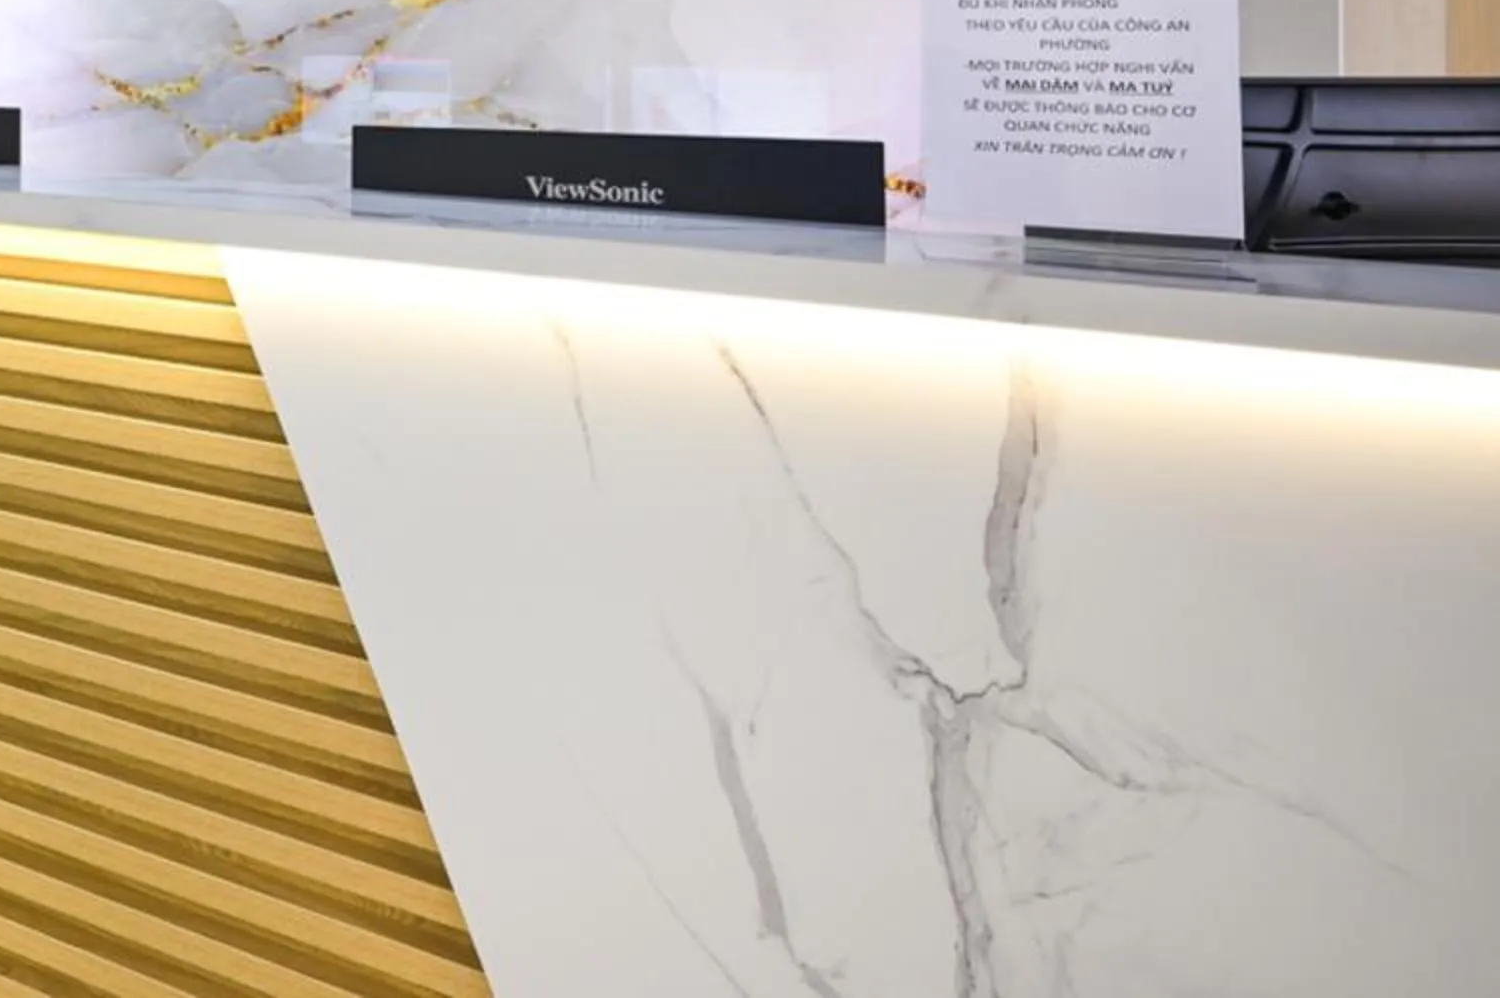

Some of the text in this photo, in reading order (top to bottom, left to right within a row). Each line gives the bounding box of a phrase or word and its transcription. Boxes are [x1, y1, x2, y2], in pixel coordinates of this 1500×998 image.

[965, 18, 1006, 32] THEO
[1166, 18, 1190, 32] AN
[1113, 61, 1155, 75] NGHI
[1108, 80, 1138, 94] MA
[1132, 103, 1168, 117] CHO
[1003, 119, 1051, 133] QUAN
[974, 140, 999, 153] XIN
[525, 174, 665, 206] ViewSonic
